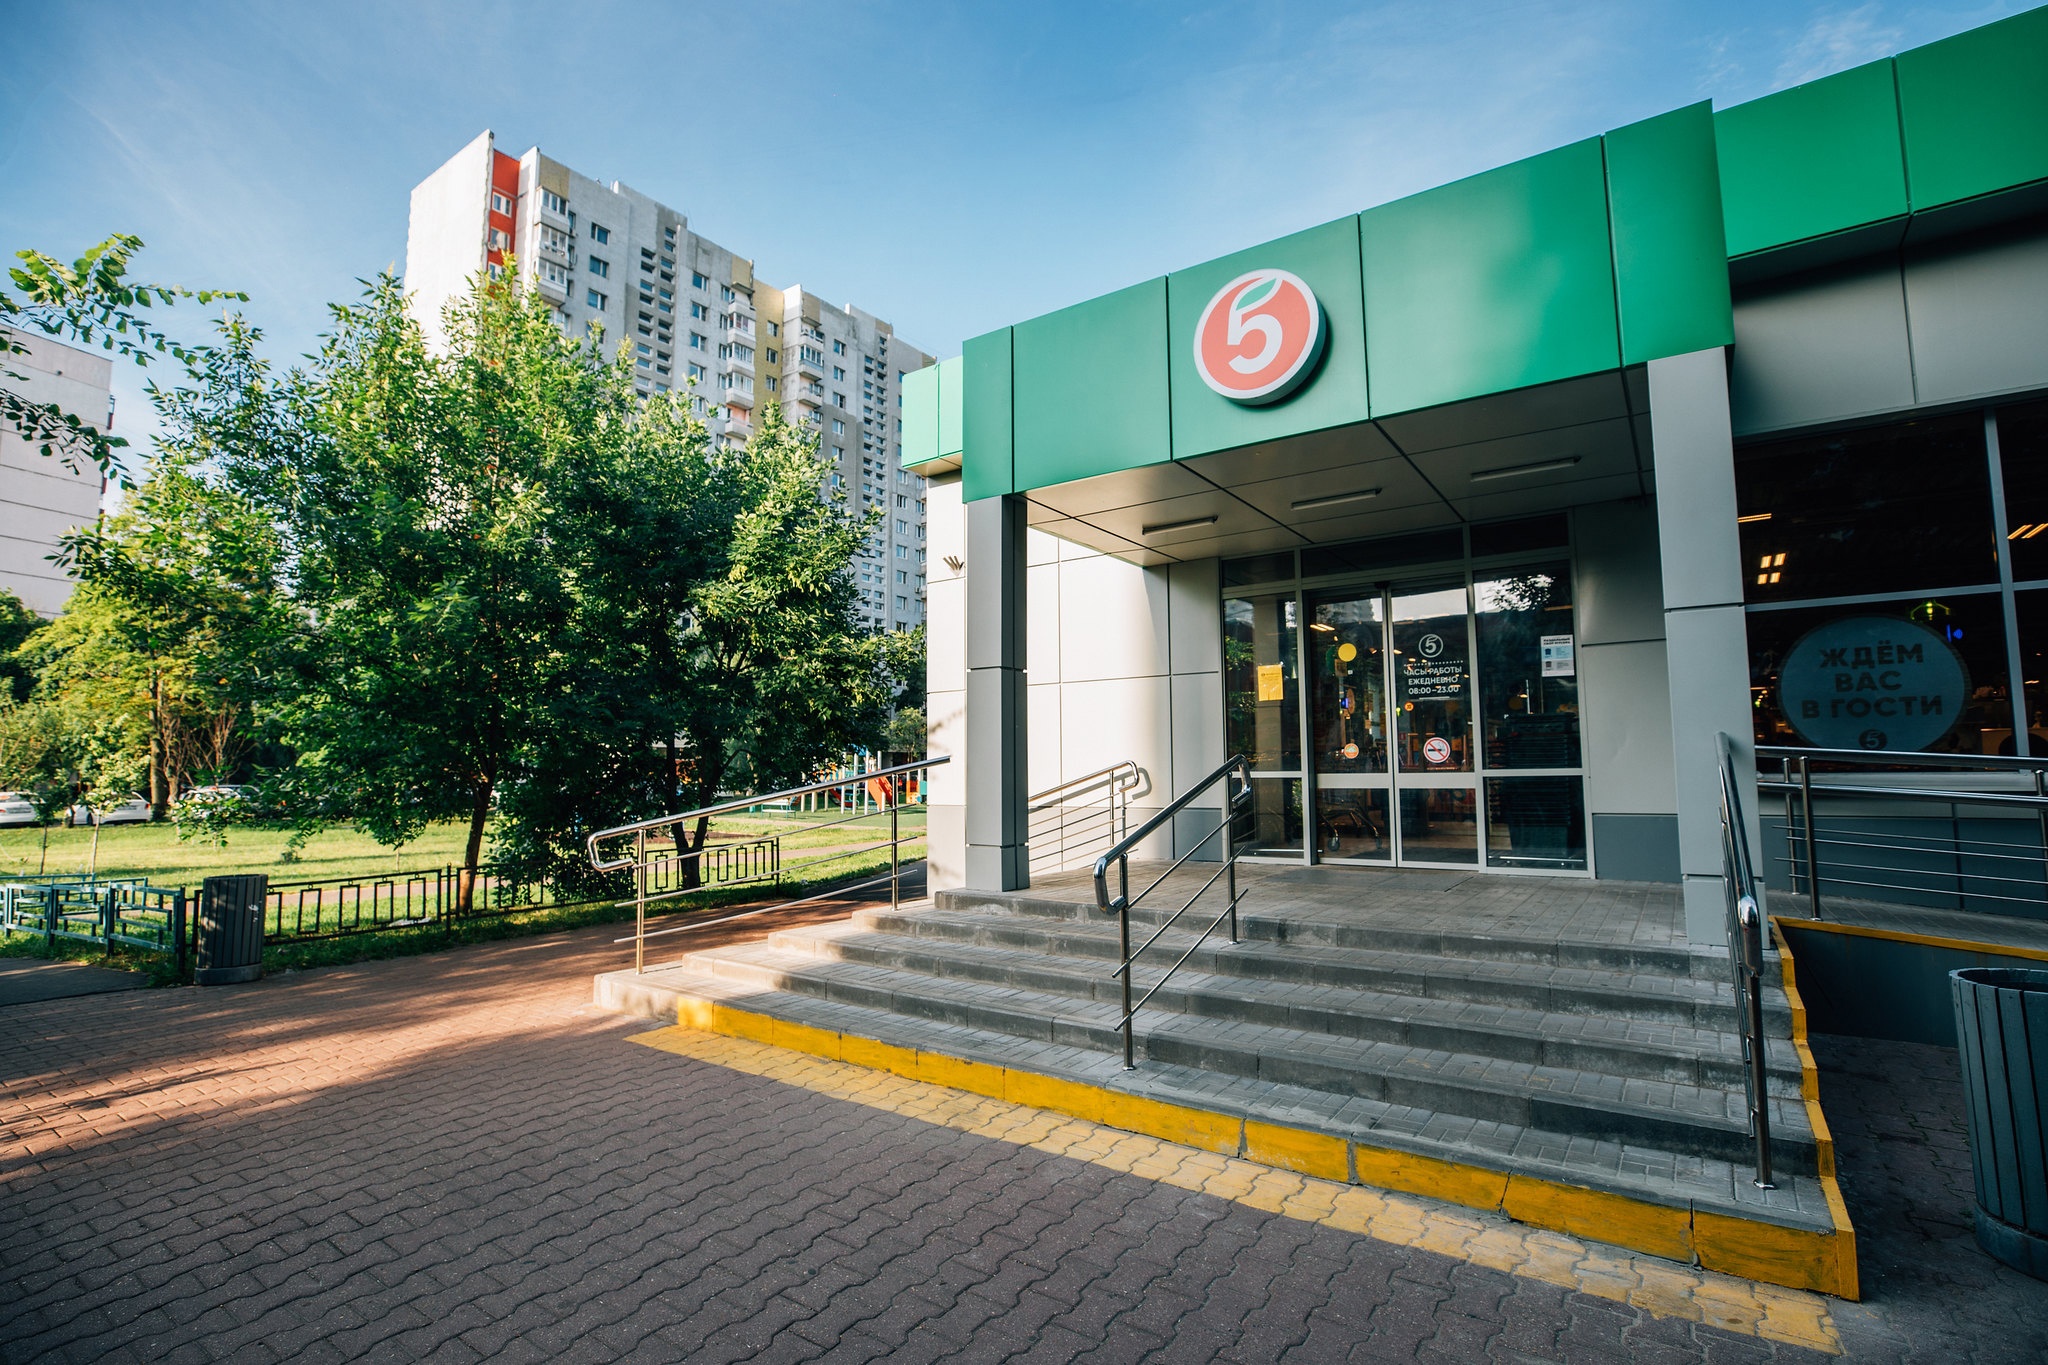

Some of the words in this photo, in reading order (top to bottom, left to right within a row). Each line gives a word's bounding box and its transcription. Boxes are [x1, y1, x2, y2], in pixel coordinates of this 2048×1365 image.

[1227, 277, 1283, 375] 5
[1425, 636, 1438, 653] 5
[1820, 640, 1924, 669] ЖДЁМ
[1408, 676, 1458, 685] ЕЖЕДНЕВНО
[1429, 666, 1462, 674] РАБОТЫ
[1834, 670, 1903, 693] ВАС
[1801, 700, 1820, 719] В
[1830, 695, 1943, 719] ГОСТИ
